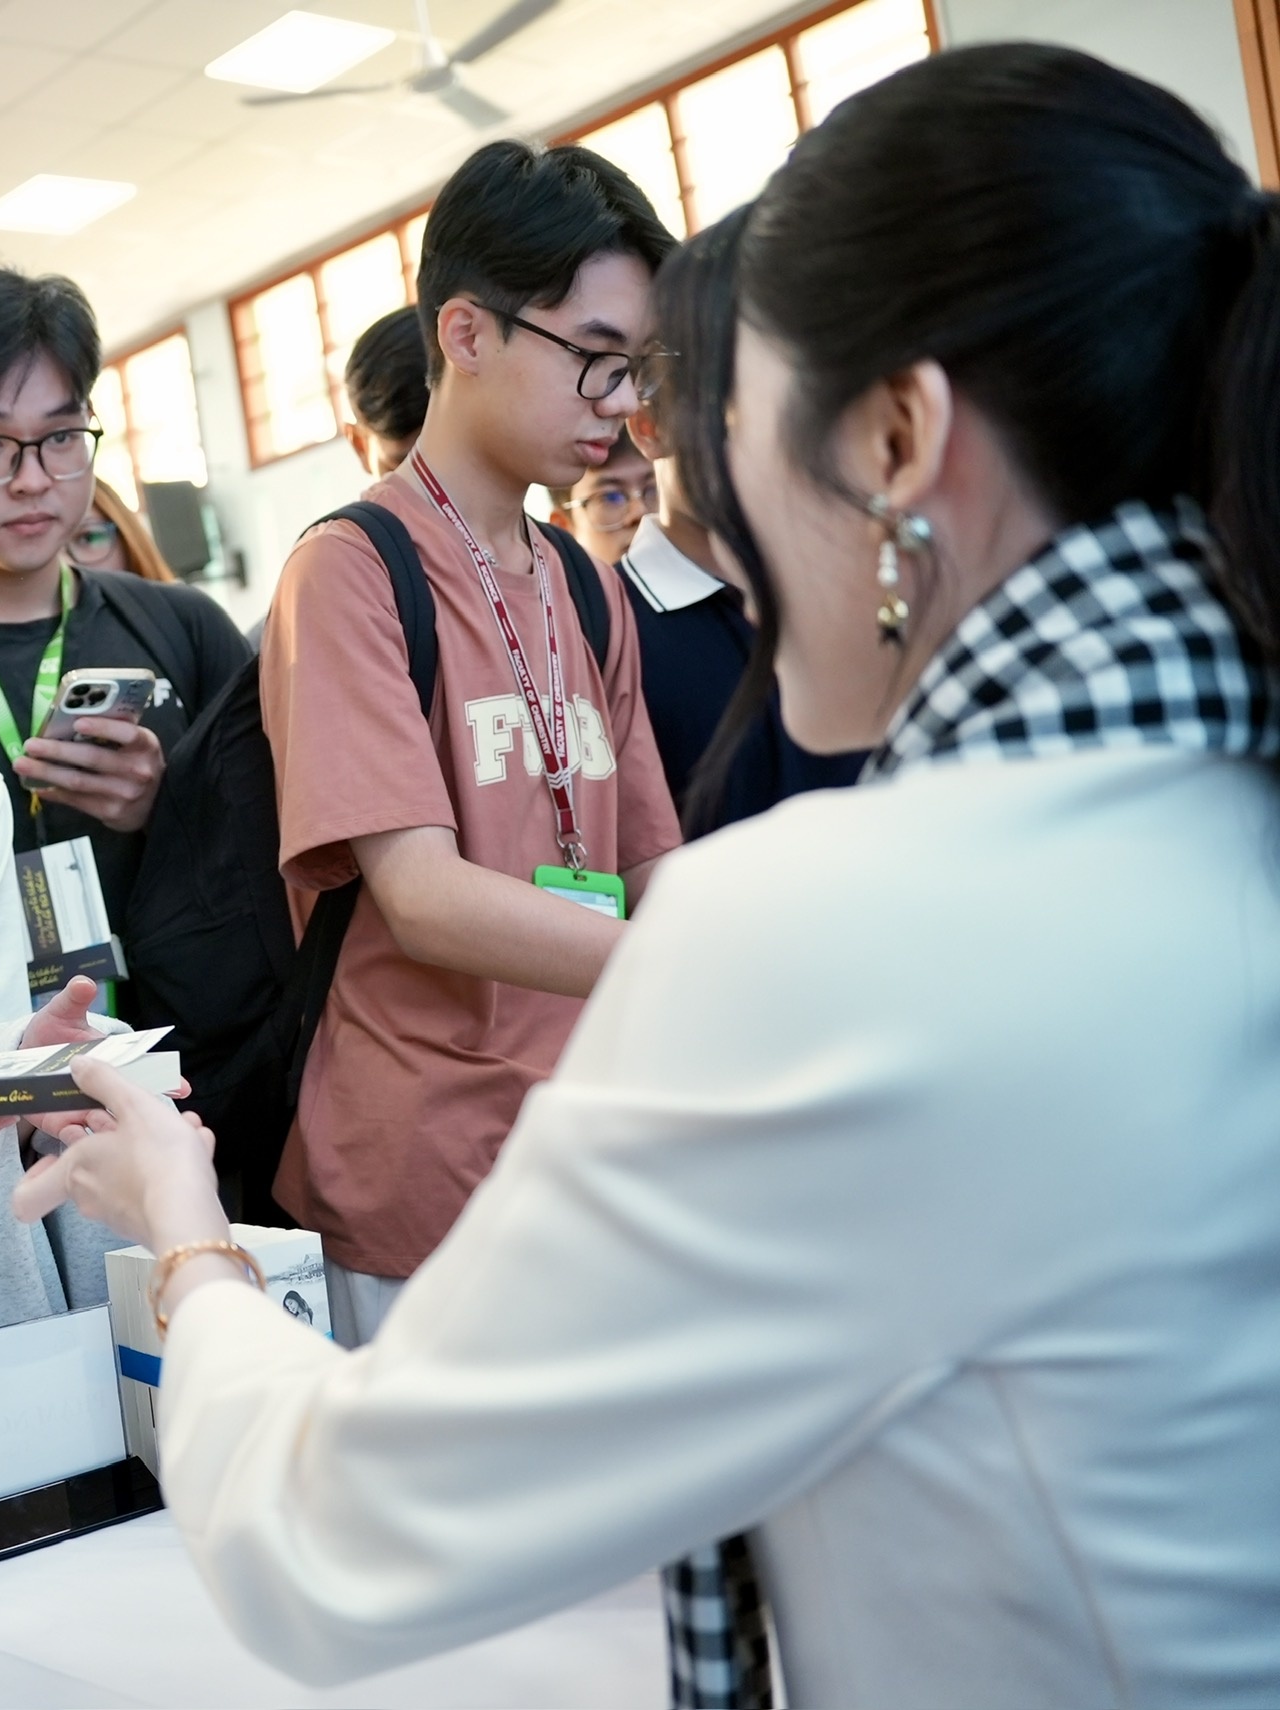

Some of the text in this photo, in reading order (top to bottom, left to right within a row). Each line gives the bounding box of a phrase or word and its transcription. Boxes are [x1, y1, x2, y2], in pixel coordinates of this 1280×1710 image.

[441, 503, 500, 604] UNIVERSITY OF SCIENCE
[511, 648, 552, 755] FACULTY OF CHEMISTRY
[551, 651, 566, 758] FACULTY OF CHEMISTRY
